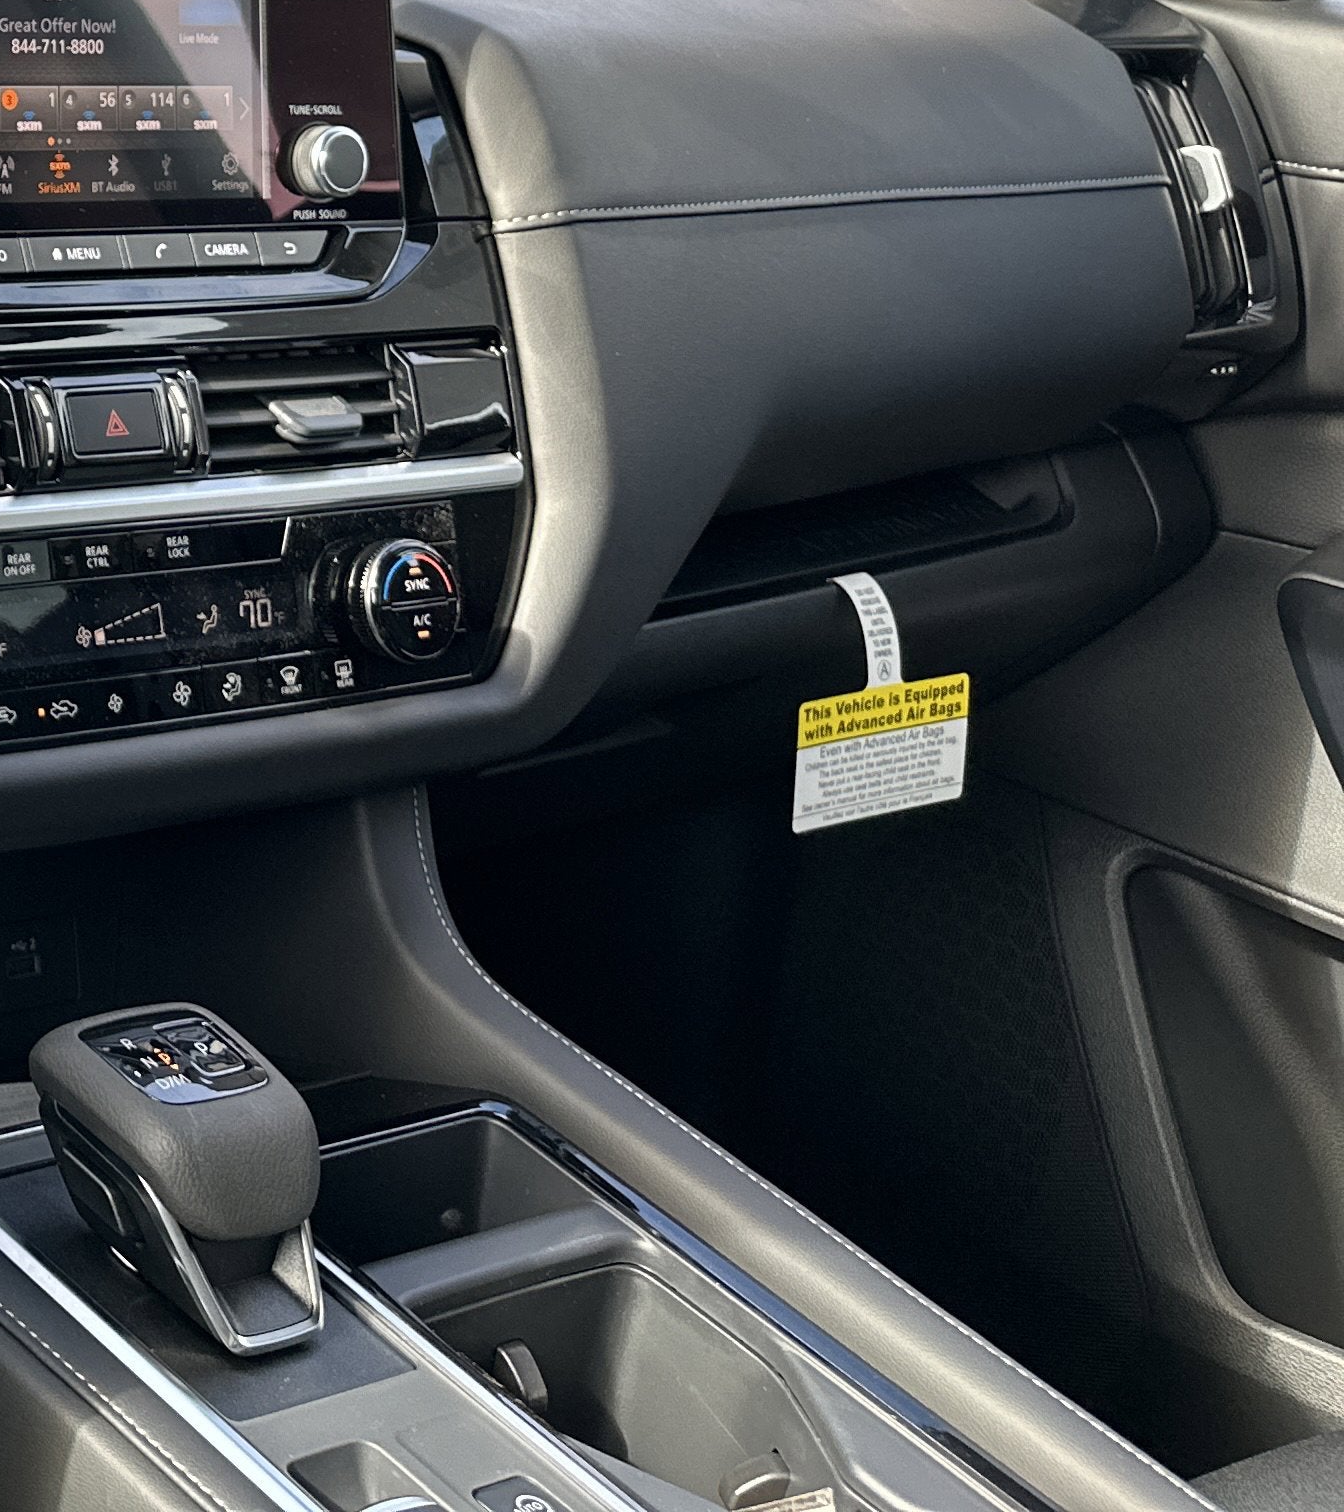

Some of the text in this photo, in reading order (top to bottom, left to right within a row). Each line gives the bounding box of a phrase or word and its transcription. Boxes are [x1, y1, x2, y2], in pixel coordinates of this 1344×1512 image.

[40, 17, 78, 34] Offer
[81, 19, 117, 35] Now!
[11, 38, 105, 56] 844-711-8800
[6, 95, 13, 106] 3
[49, 92, 55, 108] 1
[65, 94, 73, 106] 4
[99, 92, 116, 108] 56
[125, 94, 132, 106] 5
[151, 92, 174, 107] 114
[182, 93, 190, 105] 6
[224, 92, 231, 107] 1
[38, 181, 81, 194] SiriusXM
[91, 181, 136, 193] BT Audio
[212, 179, 249, 193] Settings
[293, 208, 347, 220] PUSH SOUND
[66, 246, 101, 261] MENU
[204, 243, 249, 257] CAMERA
[166, 536, 190, 547] REAR
[85, 545, 109, 556] REAR
[167, 547, 191, 559] LOCK
[7, 553, 32, 565] REAR
[86, 556, 110, 568] CTRL
[404, 576, 431, 593] SYNC
[238, 599, 273, 629] 70
[412, 613, 432, 627] A/C
[280, 683, 303, 696] FRONT
[803, 680, 964, 721] This Vehicle is Equipped
[804, 700, 961, 740] with Advanced Air Bags
[820, 724, 944, 758] Even with Advanced Air Bags
[120, 1038, 137, 1050] R
[193, 1042, 208, 1056] P
[140, 1056, 159, 1069] N
